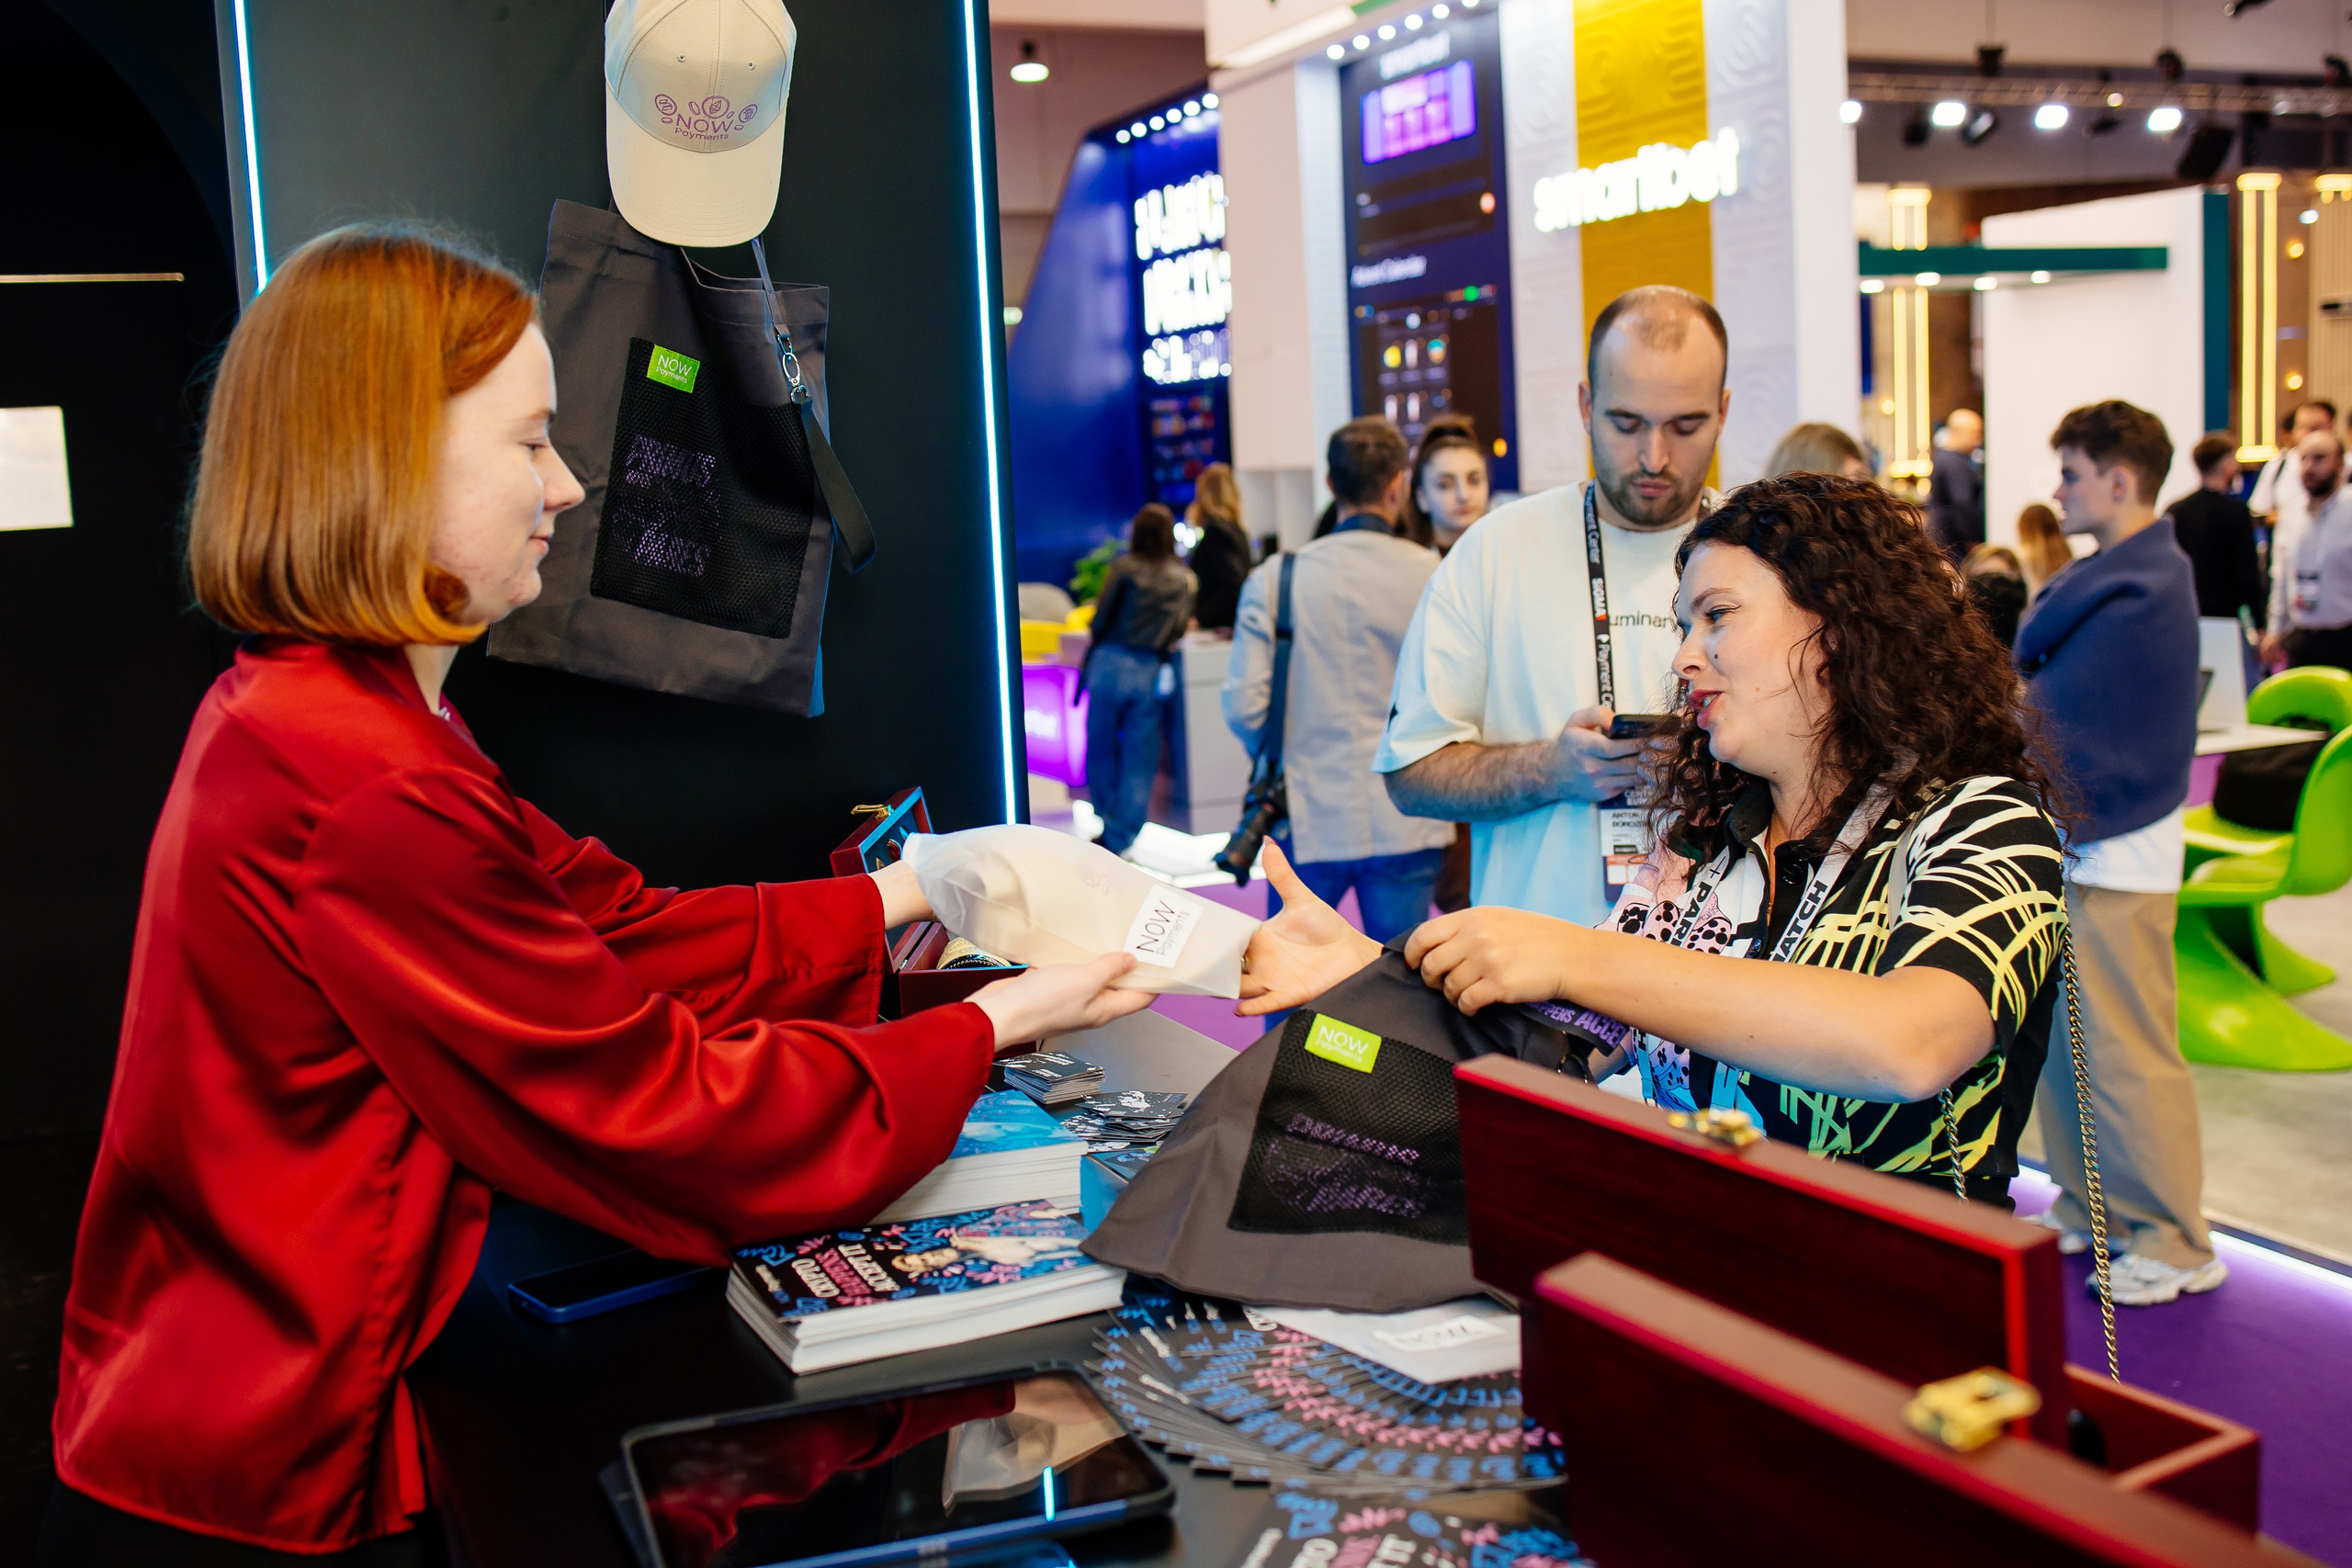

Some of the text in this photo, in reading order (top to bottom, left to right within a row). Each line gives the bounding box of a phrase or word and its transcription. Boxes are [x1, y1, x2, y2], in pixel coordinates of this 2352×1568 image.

[674, 127, 729, 141] Payments
[676, 113, 734, 133] NOW
[655, 366, 688, 384] Payments
[658, 354, 693, 377] NOW
[1597, 644, 1612, 692] Payment
[1136, 899, 1175, 953] NOW
[1156, 910, 1190, 956] Payments
[1670, 881, 1713, 948] PARI
[1318, 1024, 1370, 1055] NOW
[791, 1258, 841, 1298] CRYPTO
[837, 1243, 901, 1292] ACCEPT IT
